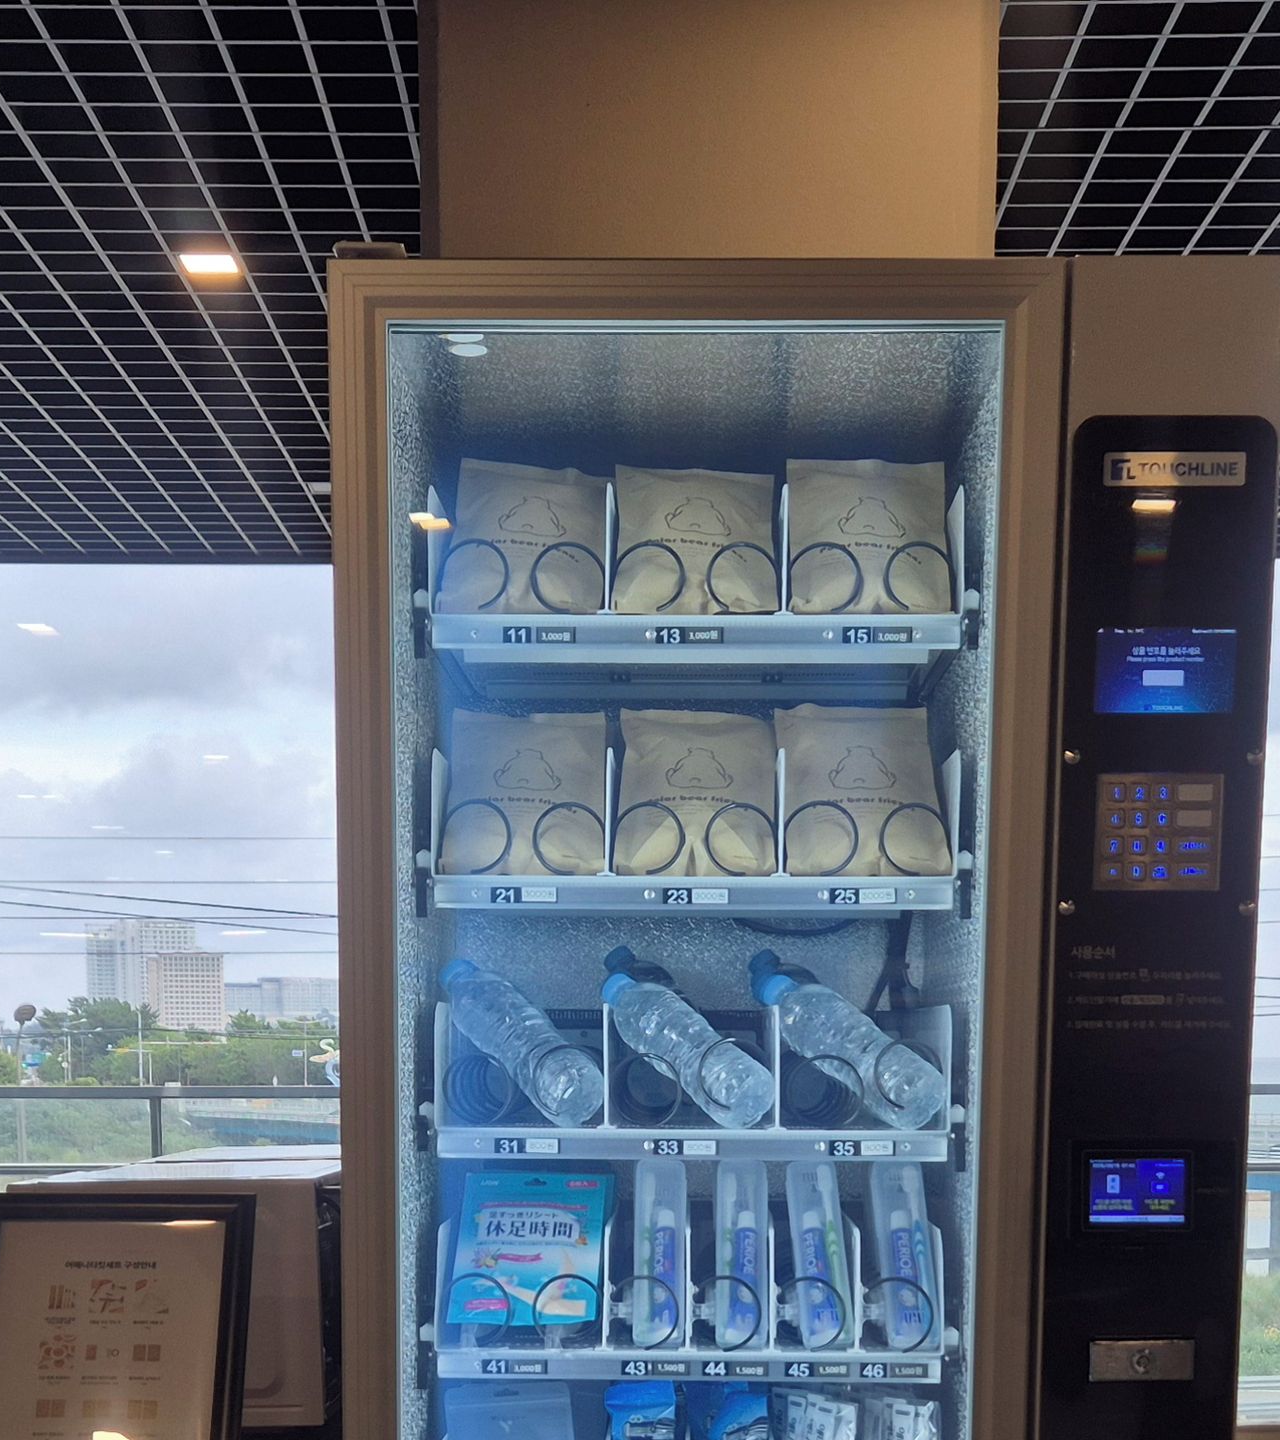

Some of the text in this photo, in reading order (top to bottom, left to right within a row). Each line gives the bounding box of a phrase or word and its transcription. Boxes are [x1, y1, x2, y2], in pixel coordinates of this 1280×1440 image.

[1138, 462, 1238, 477] TOUCHLINE
[507, 629, 527, 643] 11
[659, 628, 681, 644] 13
[846, 628, 869, 644] 15
[495, 889, 515, 903] 21
[667, 890, 688, 904] 23
[834, 890, 856, 904] 25
[1071, 945, 1116, 959] 사용순서
[499, 1140, 518, 1154] 31
[657, 1141, 679, 1155] 33
[833, 1142, 854, 1155] 35
[486, 1220, 573, 1239] 休足時間
[654, 1232, 665, 1274] PERIOE
[743, 1232, 756, 1275] PERIOE
[804, 1232, 818, 1276] PERIOE
[897, 1232, 913, 1277] PERIOE
[486, 1360, 506, 1374] 41
[624, 1361, 646, 1375] 43
[704, 1361, 727, 1376] 44
[788, 1363, 810, 1377] 45
[862, 1364, 884, 1378] 46
